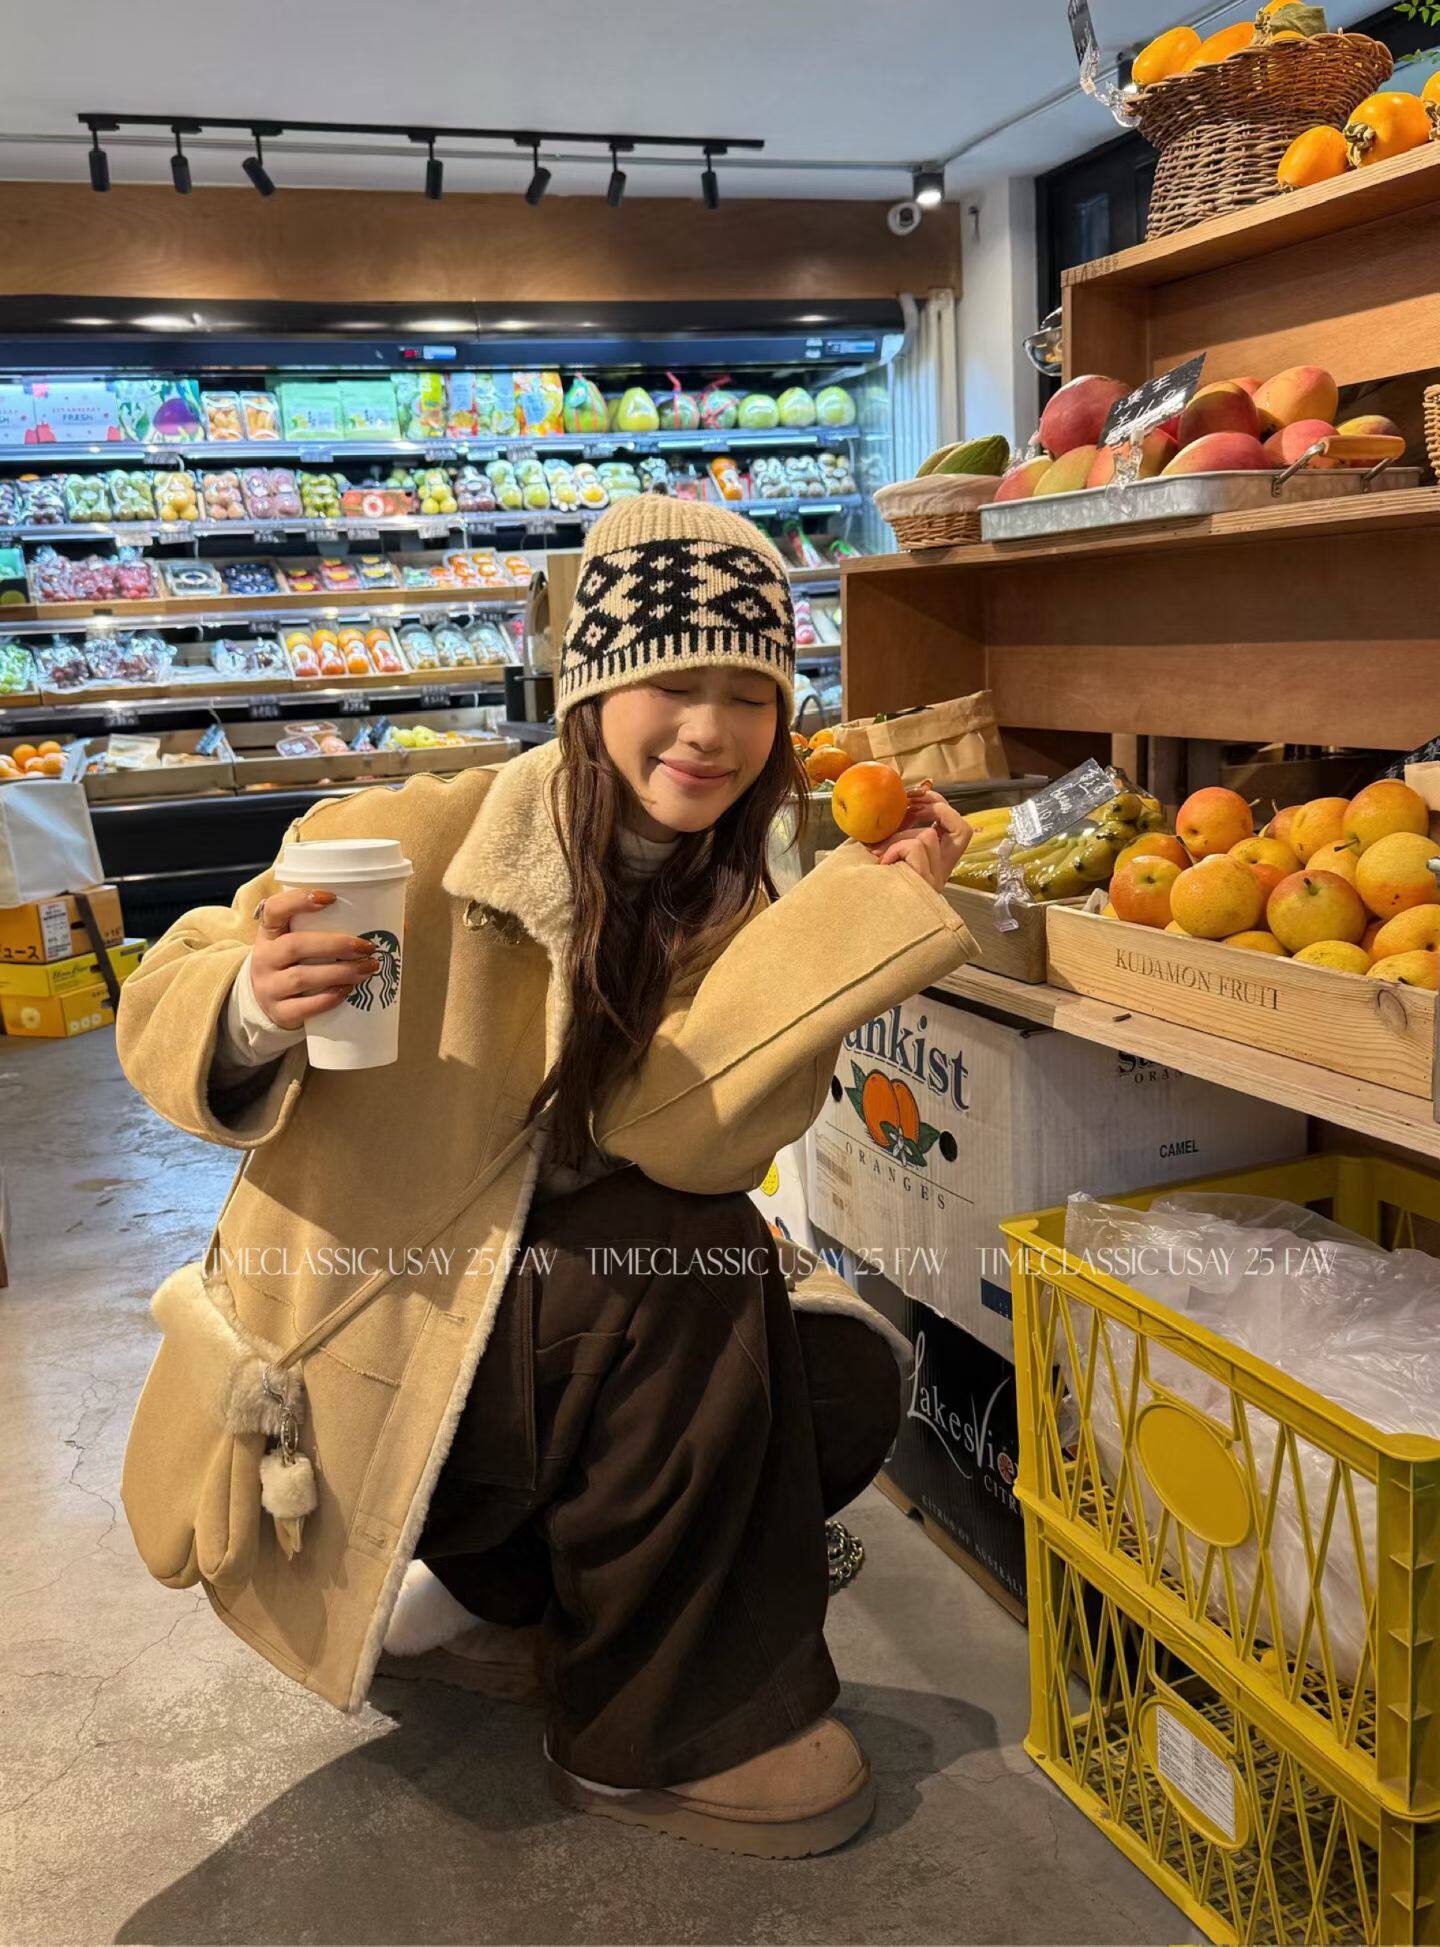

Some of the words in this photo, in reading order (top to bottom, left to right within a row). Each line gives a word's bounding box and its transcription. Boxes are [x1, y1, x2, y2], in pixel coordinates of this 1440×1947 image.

[62, 413, 94, 422] FRESH
[1115, 948, 1211, 993] KUDAMON
[1218, 975, 1280, 1011] FRUIT
[844, 1005, 971, 1112] unkist
[845, 1141, 946, 1210] ORANGES
[1159, 1140, 1199, 1159] CAMEL
[983, 1474, 1023, 1518] CITR
